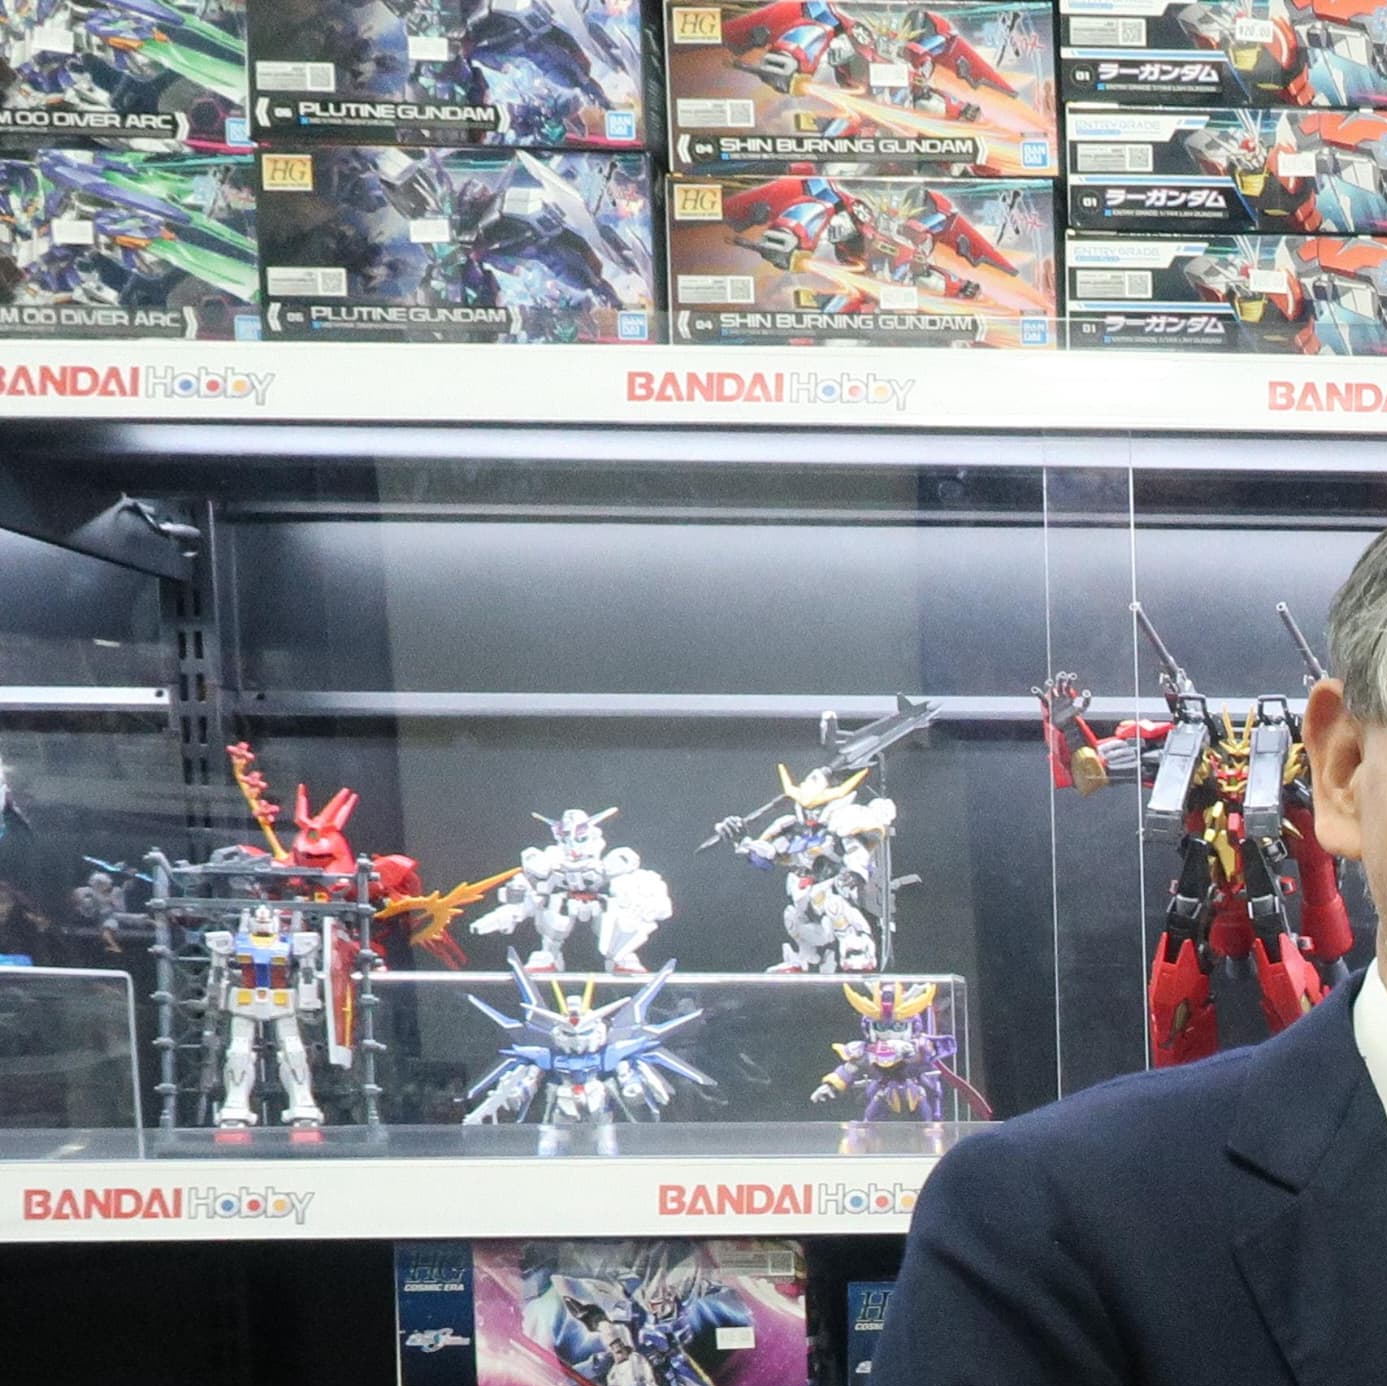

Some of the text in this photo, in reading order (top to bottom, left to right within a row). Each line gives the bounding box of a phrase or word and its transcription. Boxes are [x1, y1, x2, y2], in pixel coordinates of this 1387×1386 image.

[682, 12, 718, 36] HG
[1098, 62, 1219, 84] ラーガンダム
[53, 112, 174, 130] DIVER ARC
[300, 102, 497, 123] PLUTINE GUNDAM
[720, 137, 974, 157] SHIN BURNING GUNDAM
[266, 158, 308, 184] HG
[1105, 188, 1227, 209] ラーガンダム
[0, 365, 276, 406] ANDAI Hobby
[627, 372, 915, 409] BANDAI Hobby
[24, 1187, 315, 1224] BANDAI Hobby
[658, 1183, 921, 1215] BANDAI Hobb
